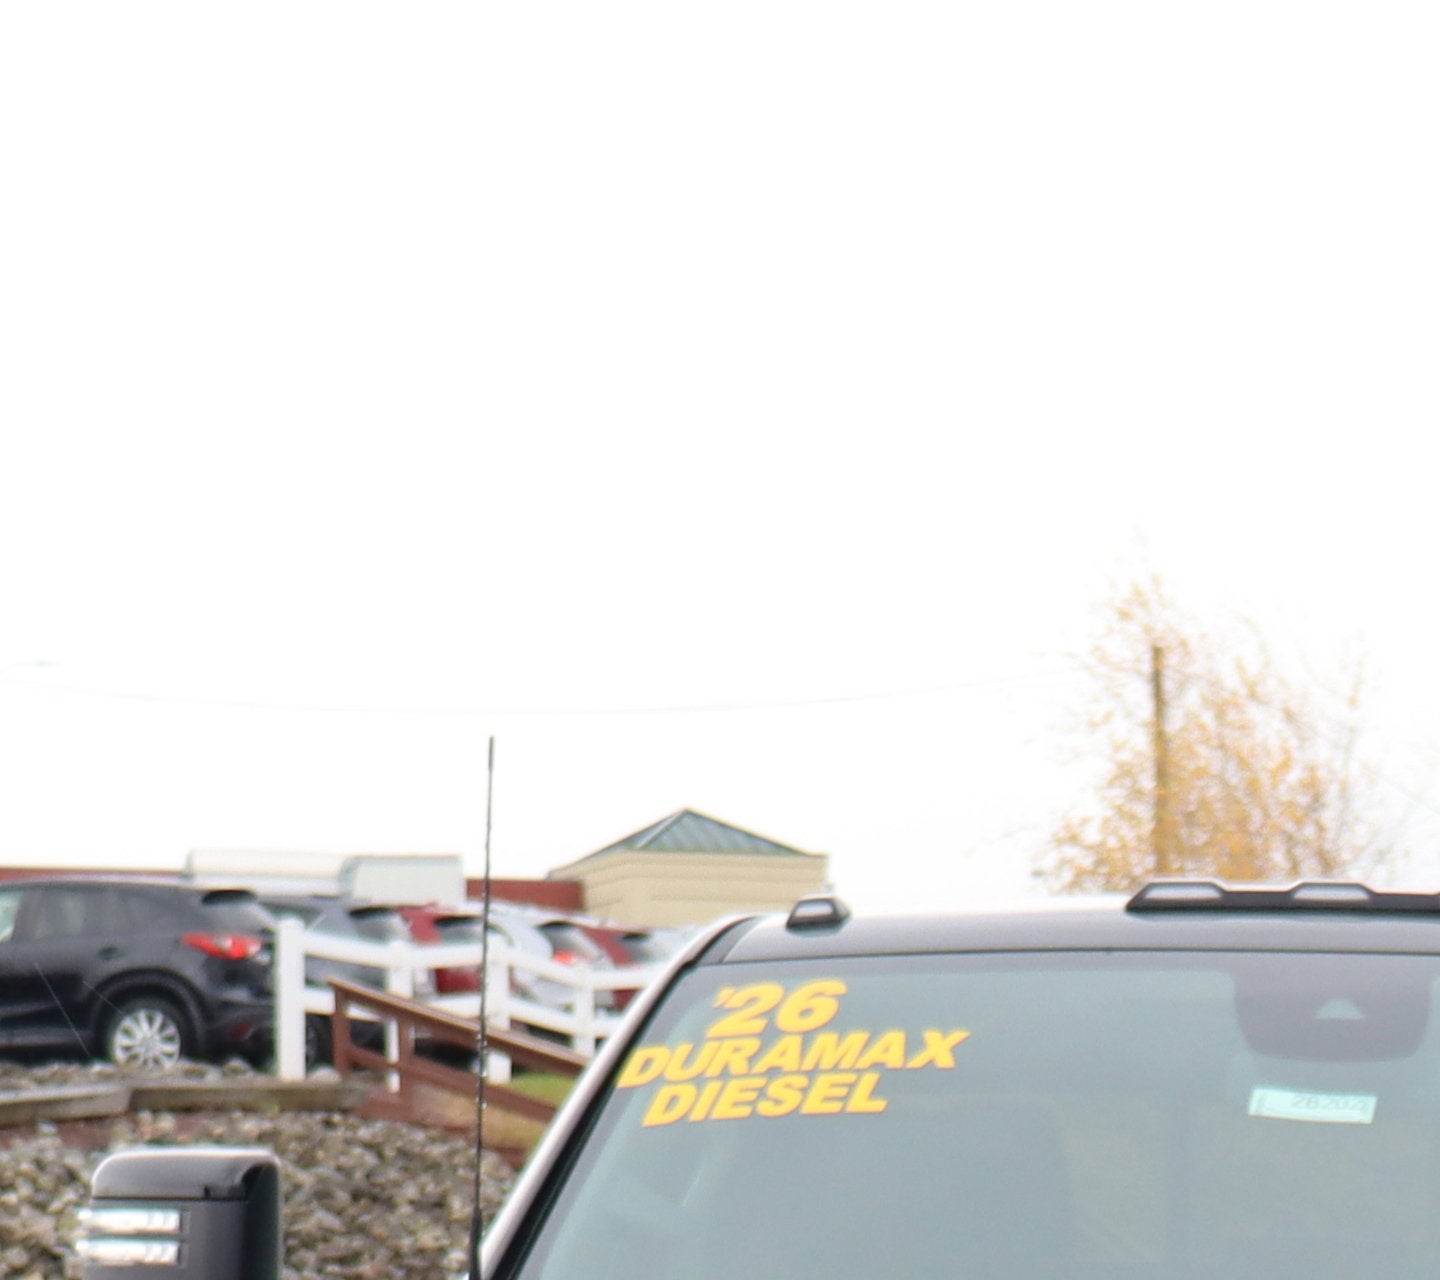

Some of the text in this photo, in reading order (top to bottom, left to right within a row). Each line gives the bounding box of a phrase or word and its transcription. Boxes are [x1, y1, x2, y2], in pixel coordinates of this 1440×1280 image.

[705, 979, 848, 1039] '26
[617, 1028, 971, 1089] DURAMAX
[641, 1071, 889, 1128] DIESEL
